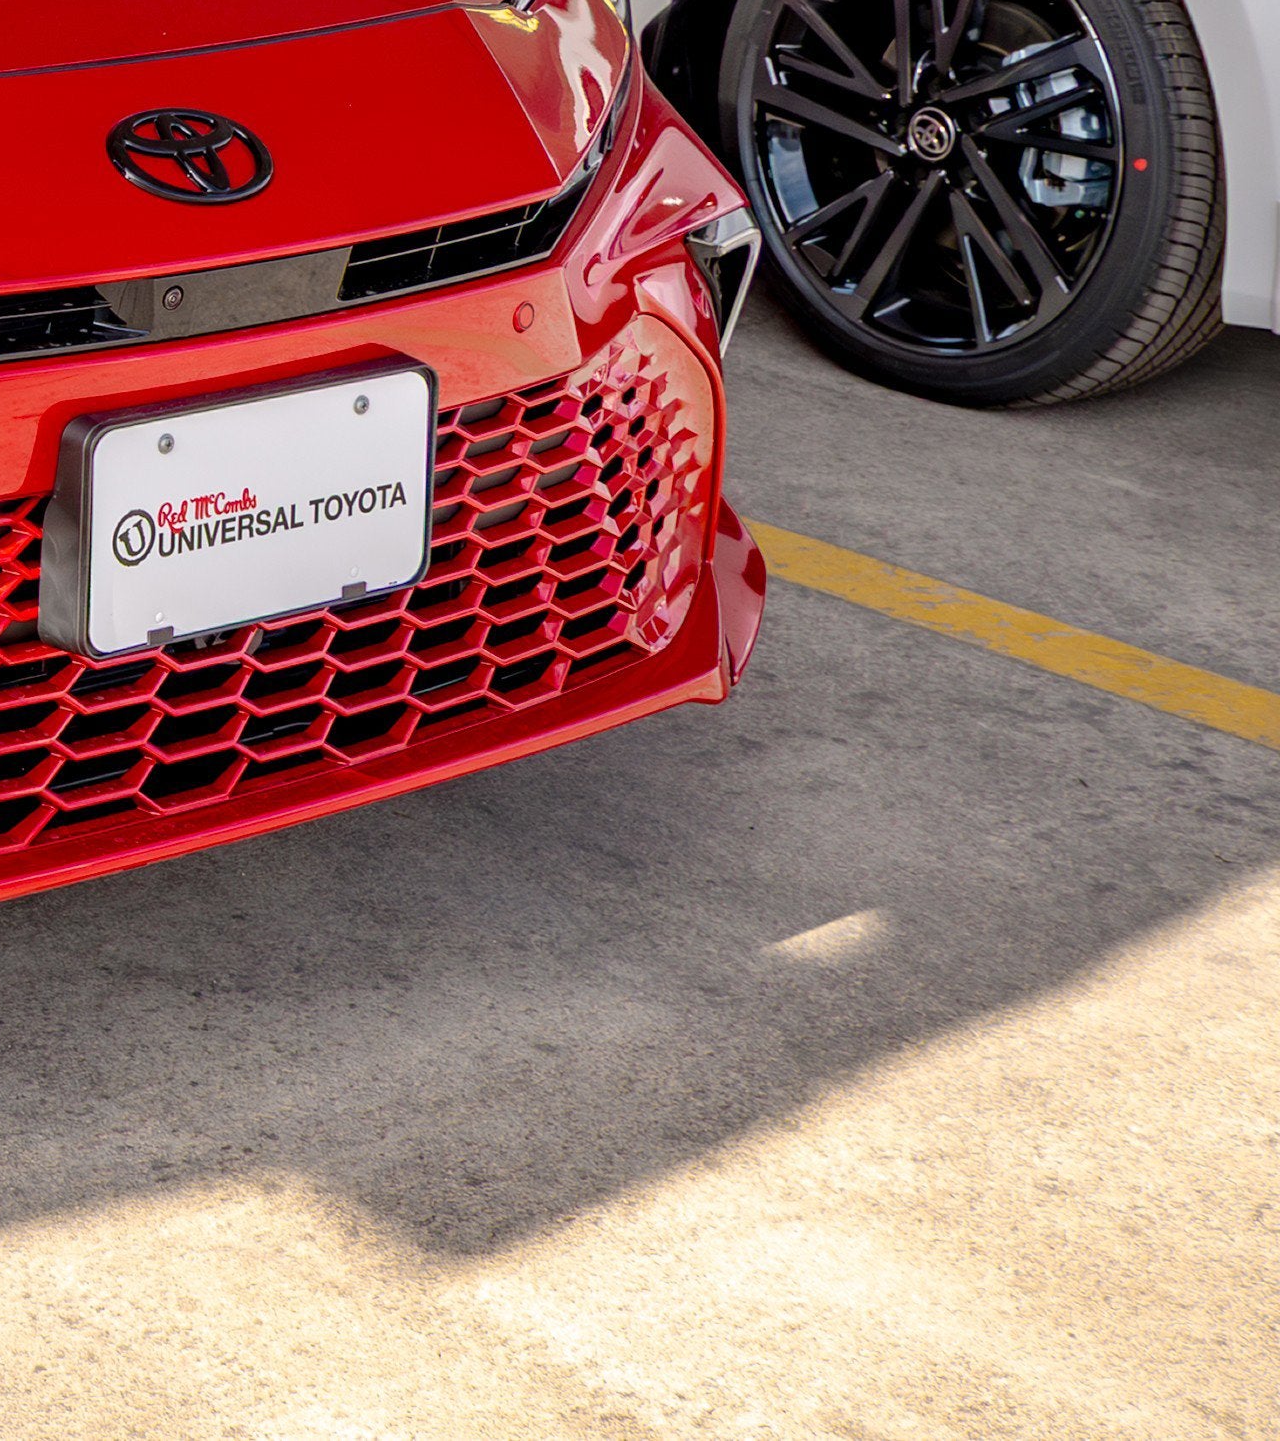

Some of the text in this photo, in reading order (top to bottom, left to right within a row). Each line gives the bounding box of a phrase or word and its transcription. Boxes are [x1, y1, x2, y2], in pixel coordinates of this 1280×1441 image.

[158, 488, 257, 534] Red McCombs
[158, 481, 407, 557] UNIVERSAL TOYOTA
